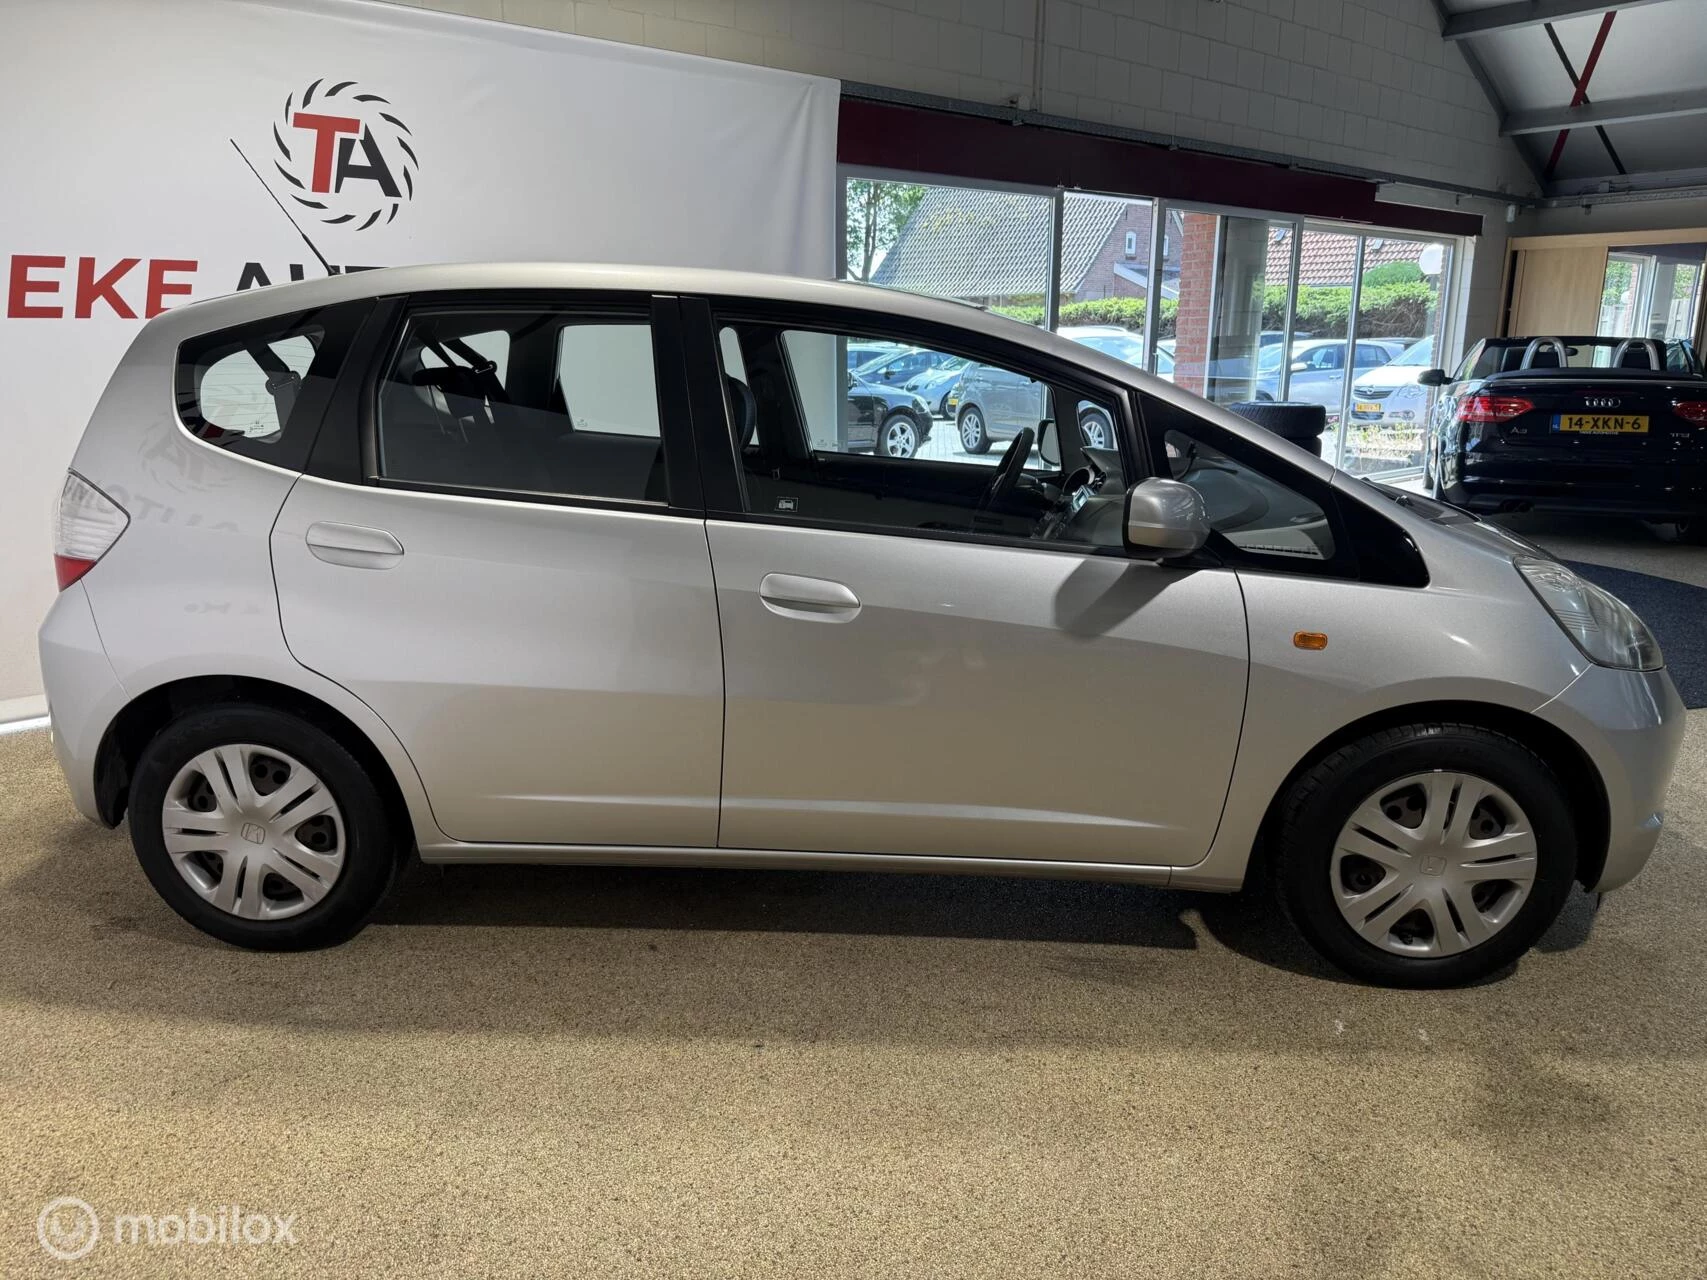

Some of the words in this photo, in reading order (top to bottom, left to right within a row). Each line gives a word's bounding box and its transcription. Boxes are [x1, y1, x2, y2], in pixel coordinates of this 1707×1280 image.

[292, 112, 402, 198] TA
[7, 254, 199, 319] EKE
[1567, 416, 1641, 430] 14-XKN-6
